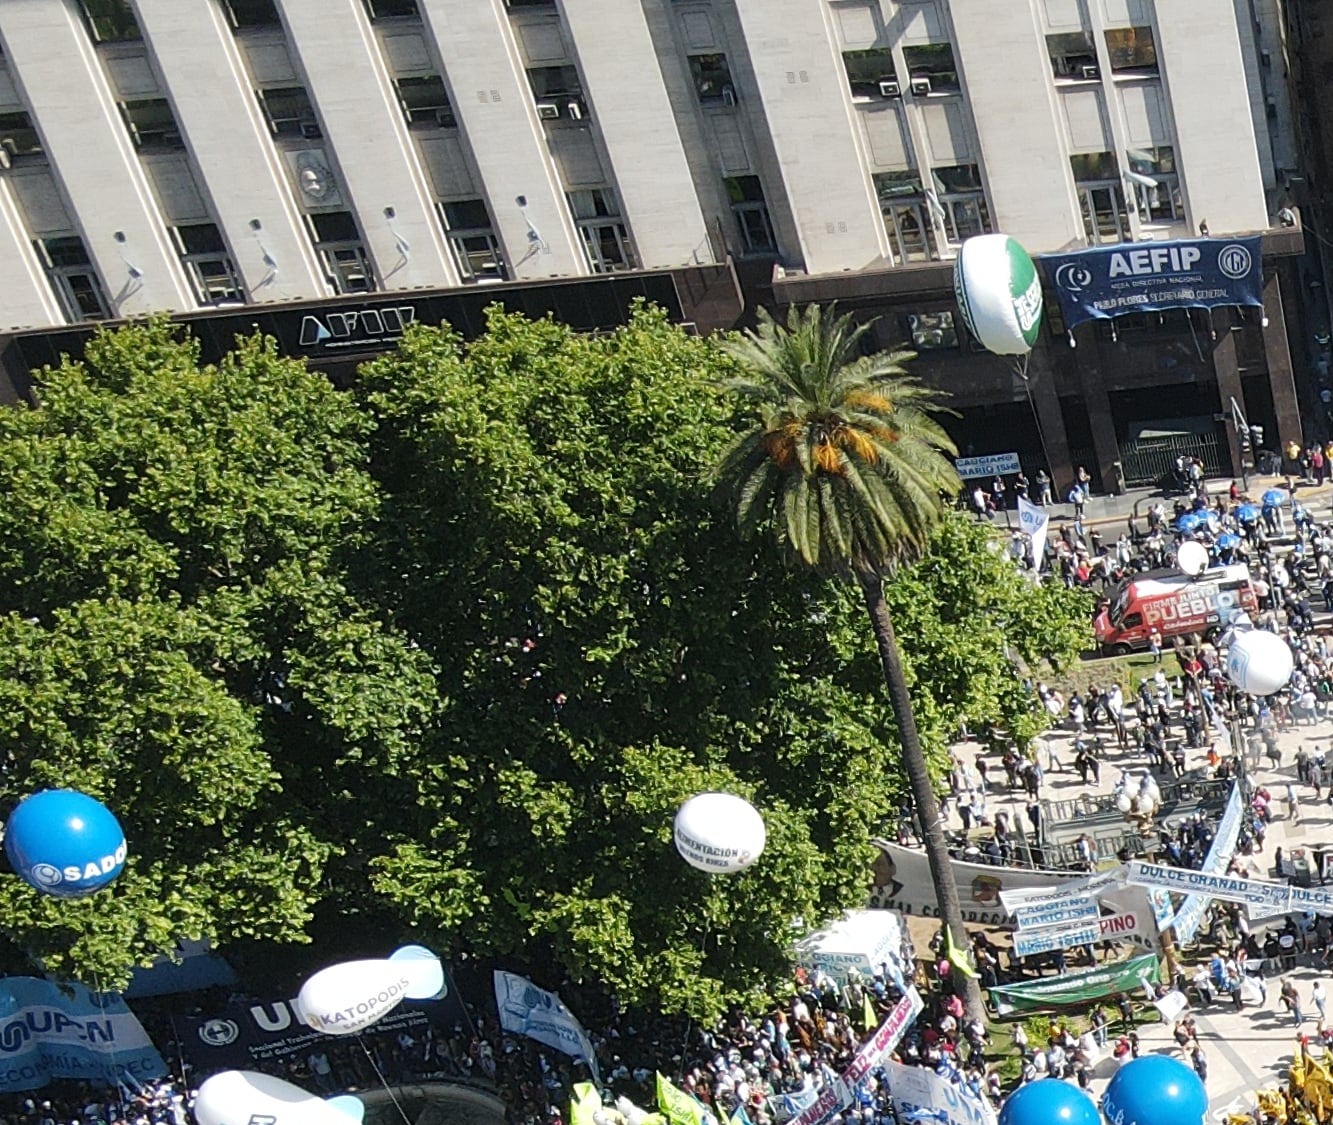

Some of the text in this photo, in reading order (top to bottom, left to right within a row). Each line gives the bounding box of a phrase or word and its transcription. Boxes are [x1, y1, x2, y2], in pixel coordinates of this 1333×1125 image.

[1109, 247, 1201, 278] AEFIP
[1145, 593, 1238, 625] PUEBLO
[1139, 864, 1185, 884] DULCE
[1291, 887, 1332, 905] DULCE
[321, 977, 410, 1027] KATOPODIS
